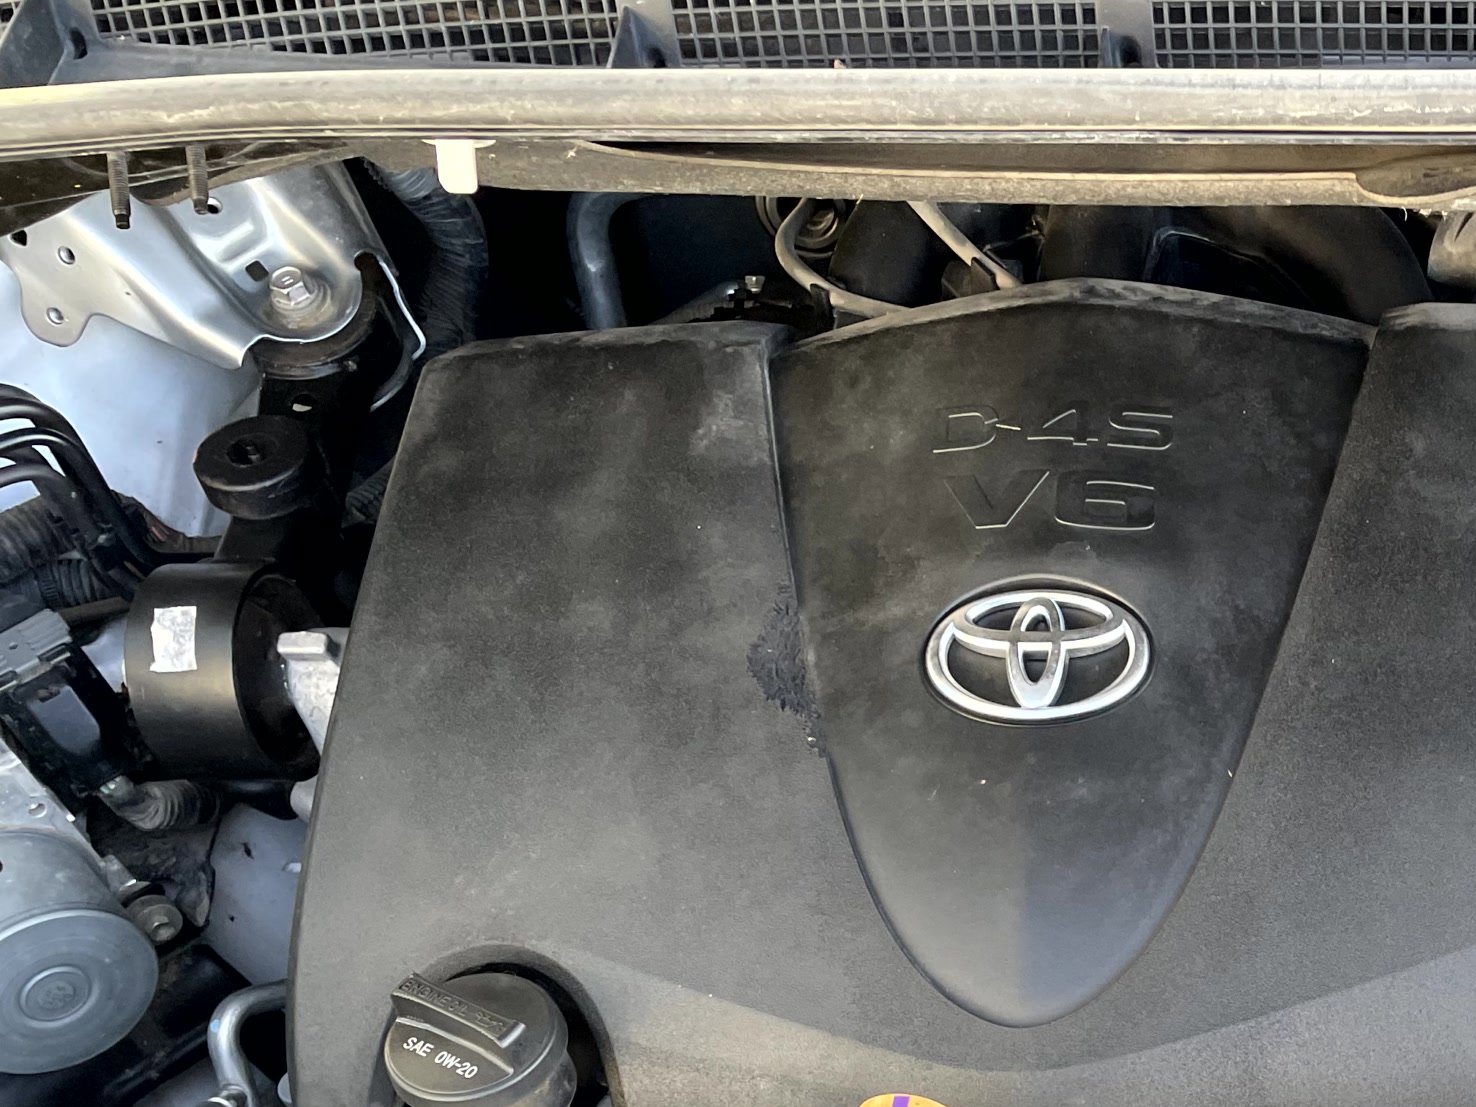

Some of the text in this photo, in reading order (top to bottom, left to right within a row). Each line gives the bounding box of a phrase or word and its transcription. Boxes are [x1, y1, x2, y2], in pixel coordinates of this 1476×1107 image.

[933, 404, 1174, 453] D-4S
[943, 467, 1157, 531] V6
[400, 980, 452, 1007] ENGINE
[403, 1037, 478, 1079] SAE 0W-20
